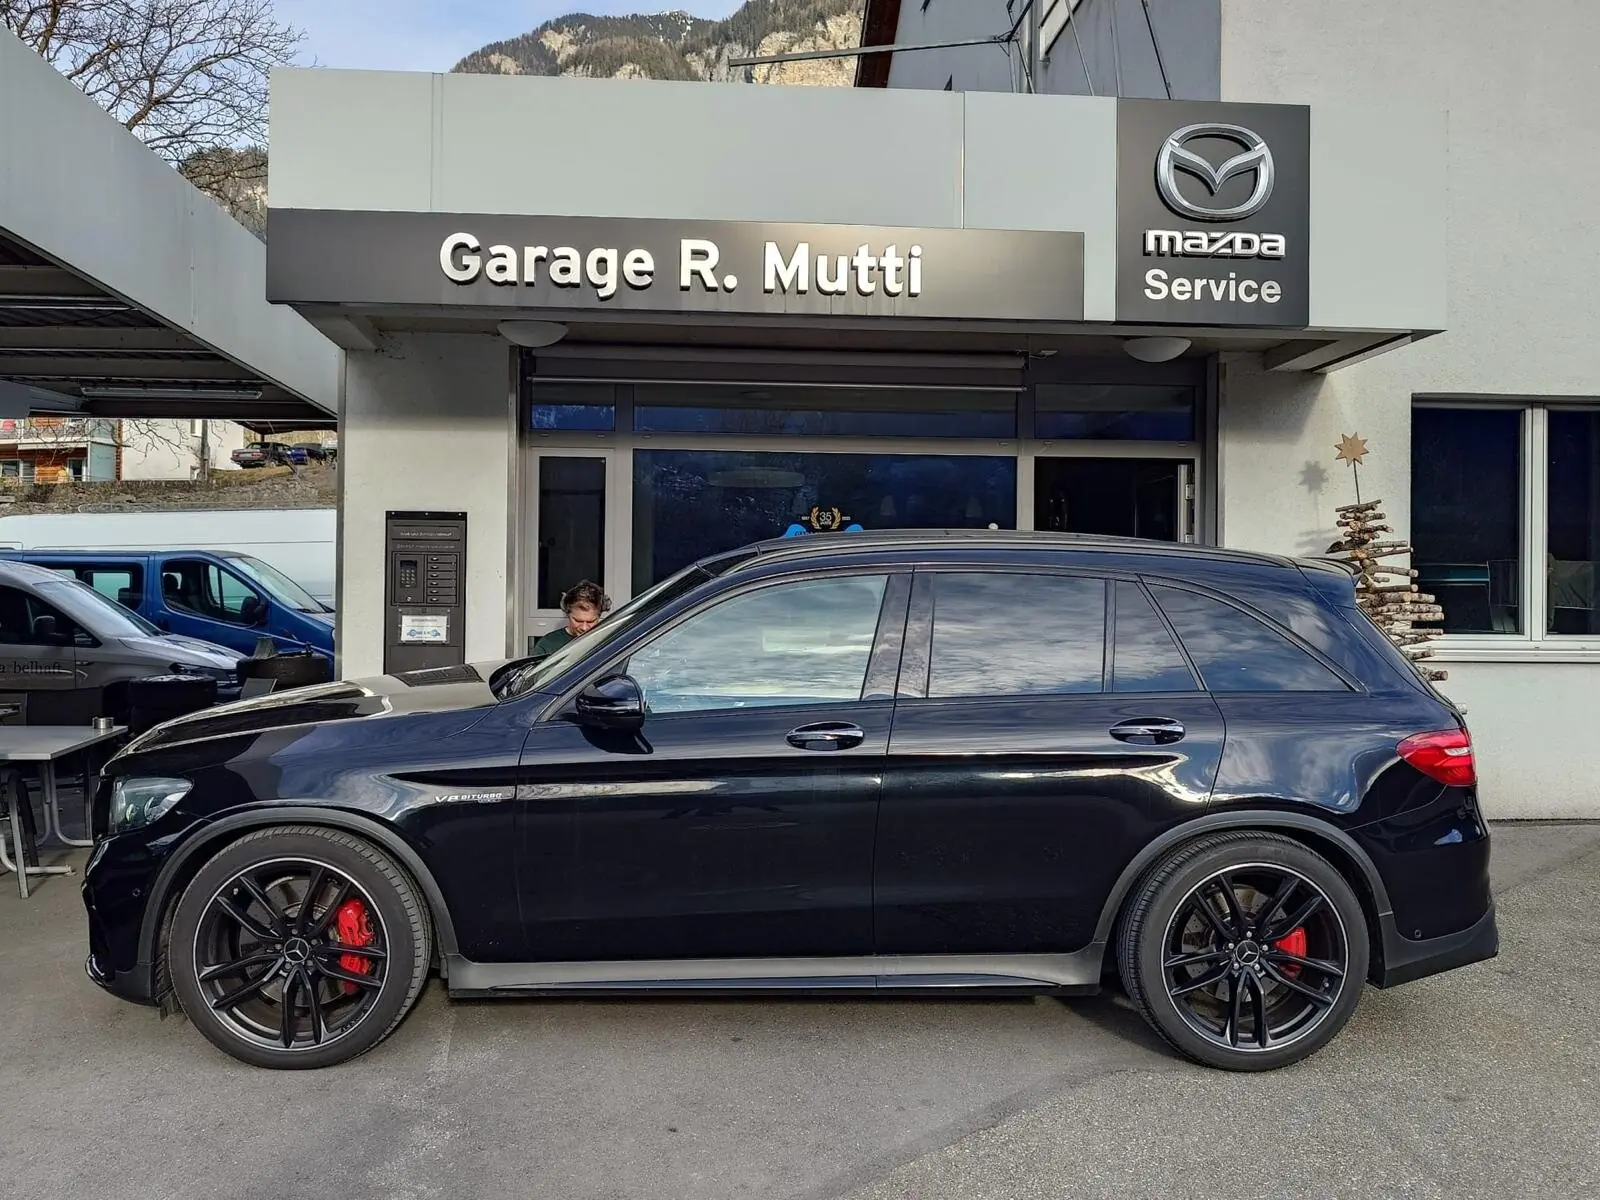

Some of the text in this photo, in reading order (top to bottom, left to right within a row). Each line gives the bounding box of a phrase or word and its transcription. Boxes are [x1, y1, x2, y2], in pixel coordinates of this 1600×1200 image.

[439, 232, 924, 301] Garage R. Mutti
[1144, 268, 1283, 304] Service
[819, 511, 832, 521] 35
[435, 793, 503, 803] V8 BITURBO
